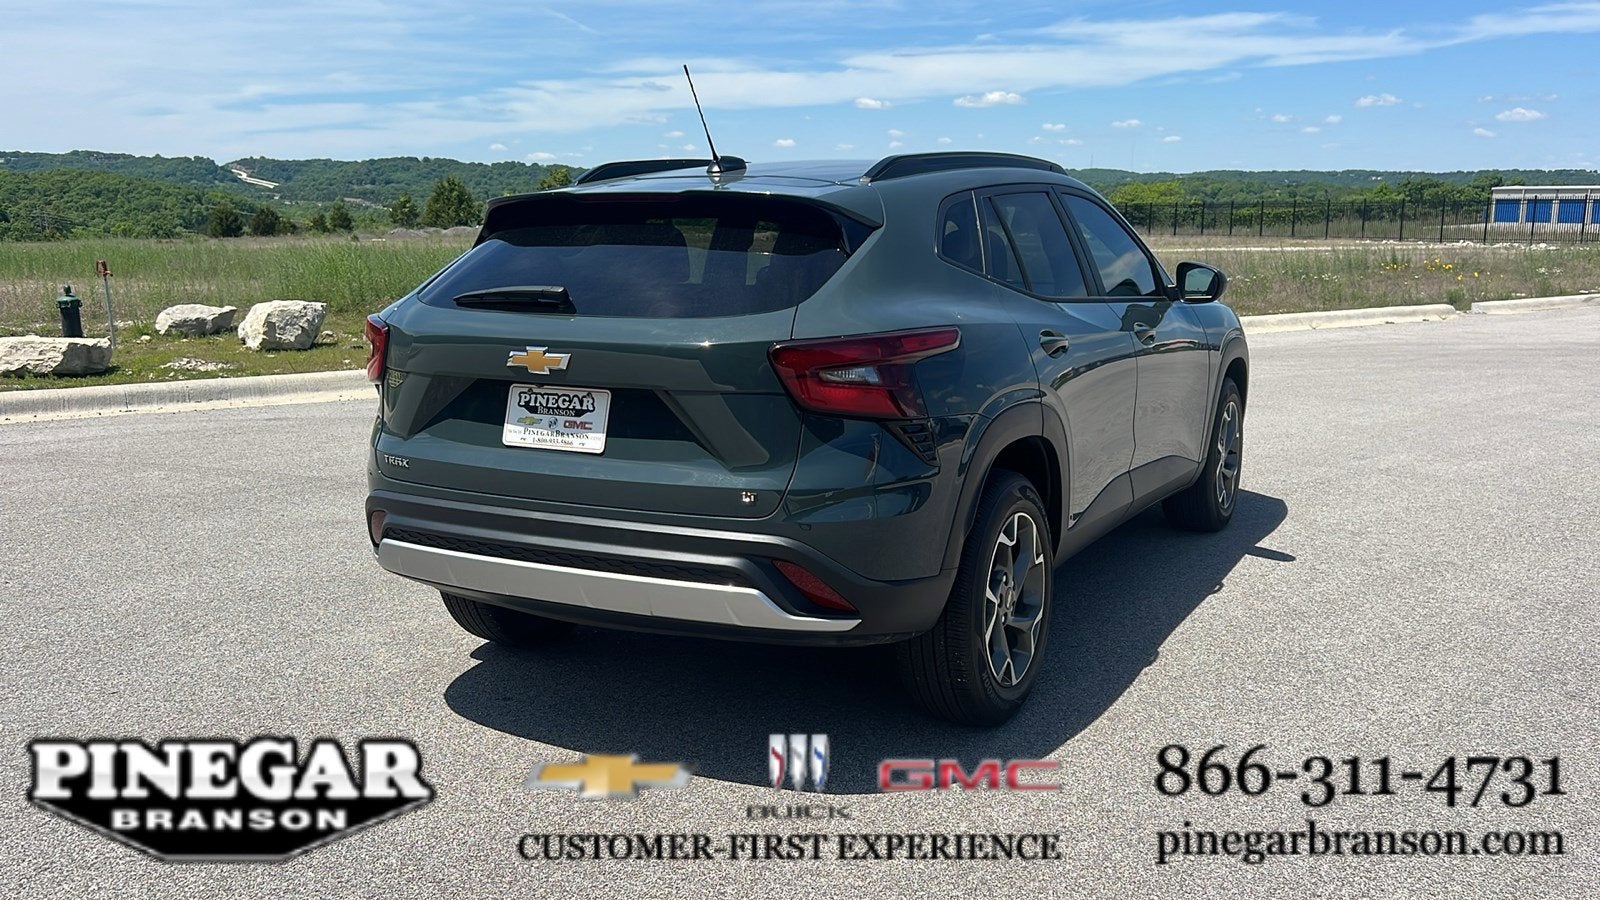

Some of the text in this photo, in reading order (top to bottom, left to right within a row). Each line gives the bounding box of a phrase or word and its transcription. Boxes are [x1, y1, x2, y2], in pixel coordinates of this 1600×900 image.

[519, 393, 594, 411] PINEGAR
[537, 407, 576, 417] BRANSON
[563, 420, 593, 430] GMC
[384, 454, 409, 468] TRAX
